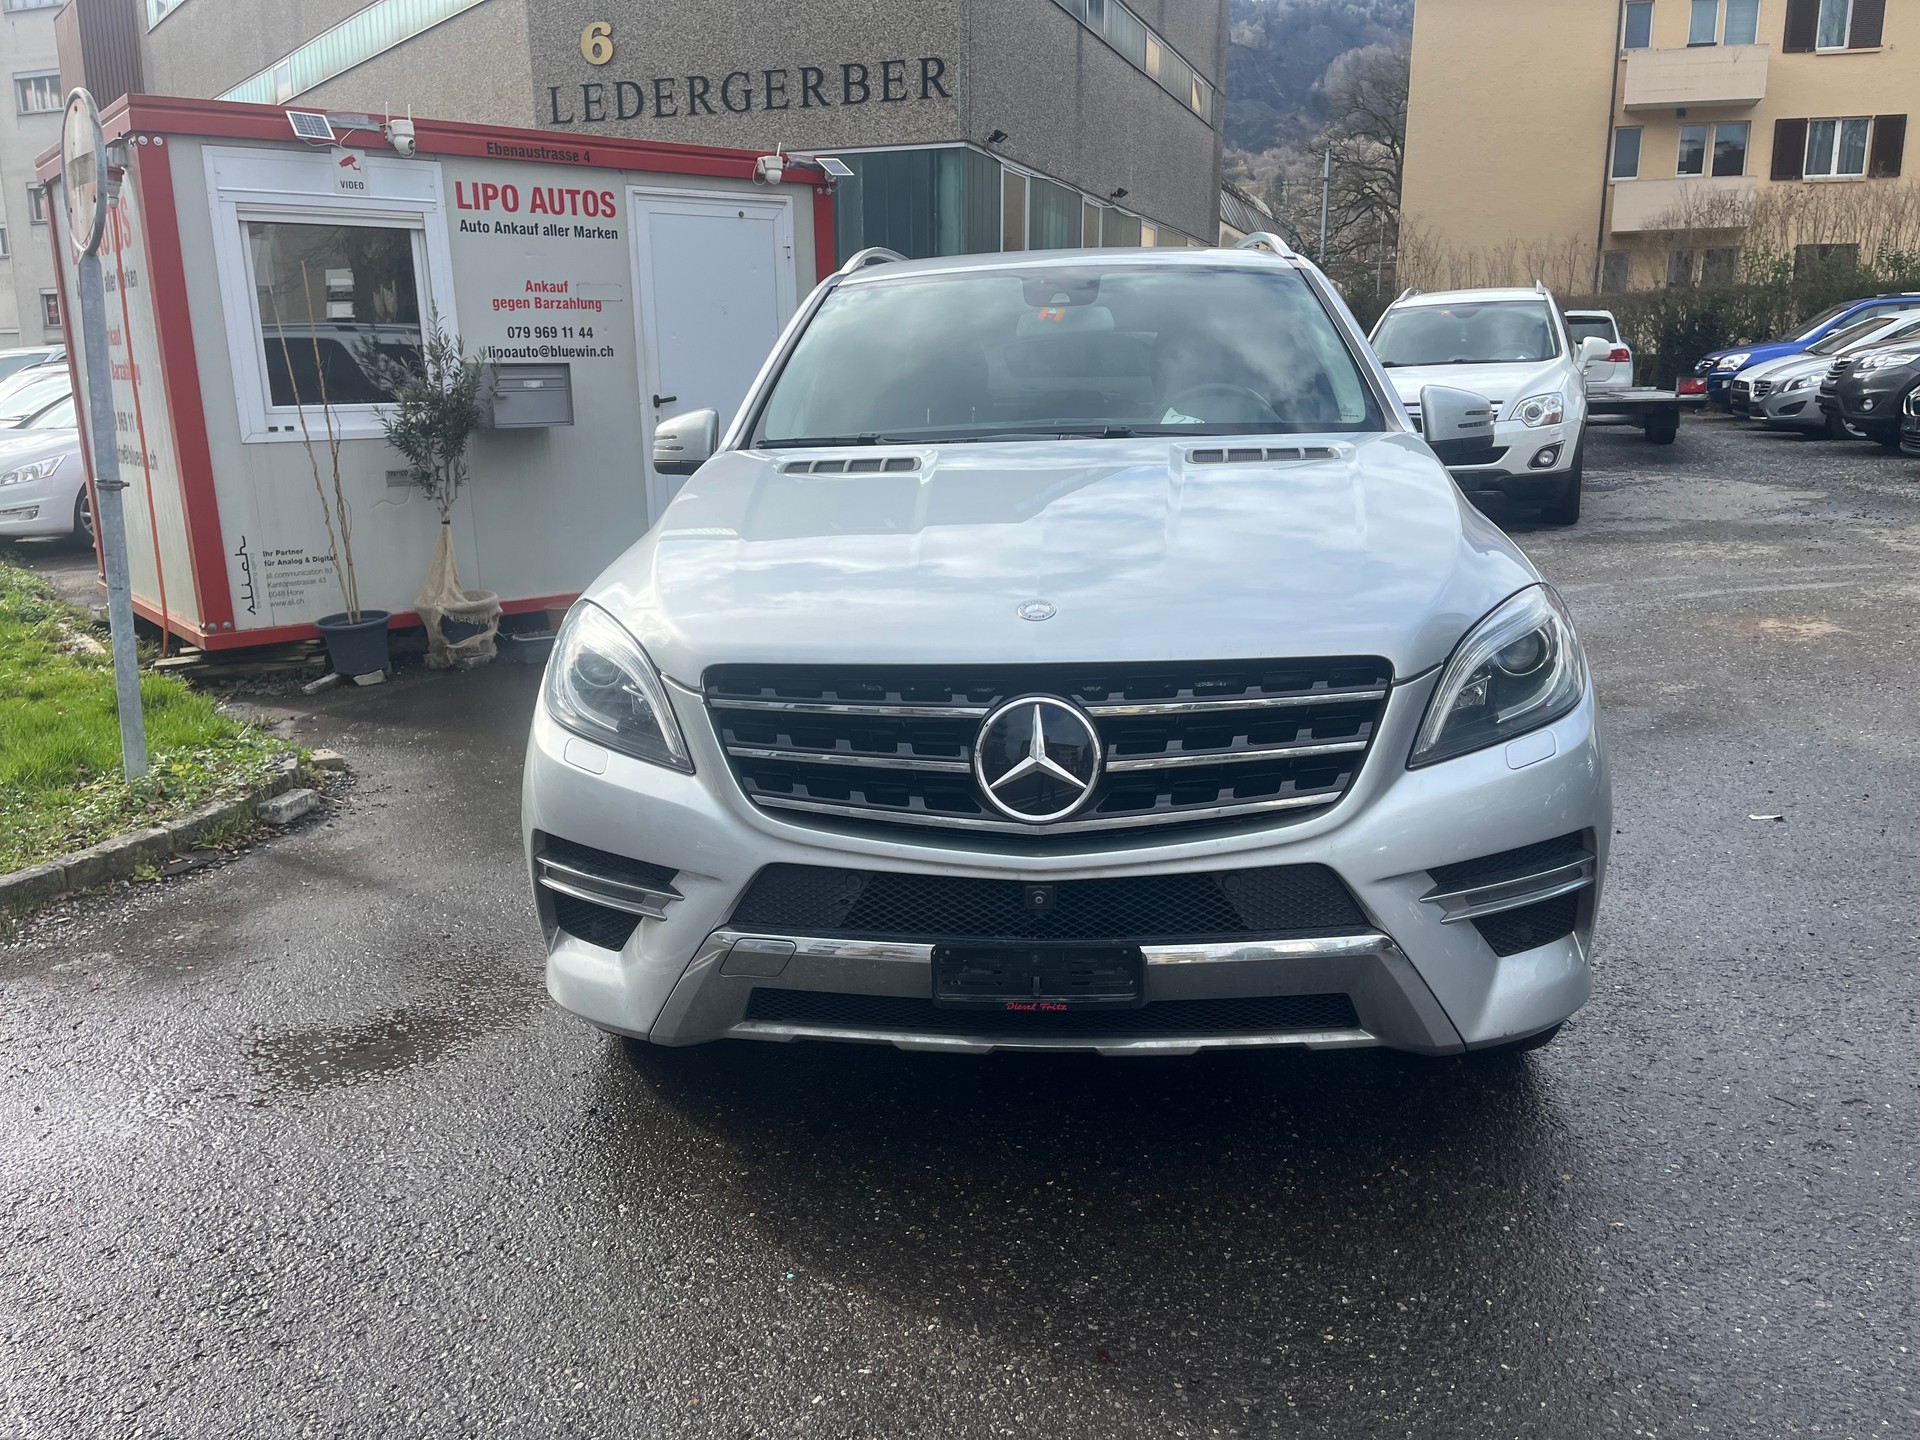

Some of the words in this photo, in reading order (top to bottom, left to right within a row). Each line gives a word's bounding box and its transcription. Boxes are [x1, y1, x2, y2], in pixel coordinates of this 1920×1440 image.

[580, 21, 614, 65] 6
[547, 57, 952, 125] LEDERGERBER
[486, 142, 580, 162] Ebenaustrasse
[583, 151, 591, 163] 4
[340, 180, 365, 190] VIDEO
[455, 181, 519, 213] LIPO
[530, 187, 617, 218] AUTOS
[460, 219, 490, 234] Auto
[494, 221, 539, 236] Ankauf
[543, 224, 570, 237] aller
[574, 226, 619, 239] Marken
[525, 280, 569, 293] Ankauf
[492, 298, 530, 311] gegen
[534, 297, 602, 312] Barzahlung
[507, 326, 531, 339] 079
[534, 326, 558, 339] 969
[561, 326, 574, 339] 11
[578, 326, 594, 339] 44
[488, 345, 614, 359] lipoauto@bluewin.ch
[277, 558, 303, 566] Analog
[1005, 1002, 1036, 1011] Diesel
[1040, 1002, 1067, 1011] Fritz
